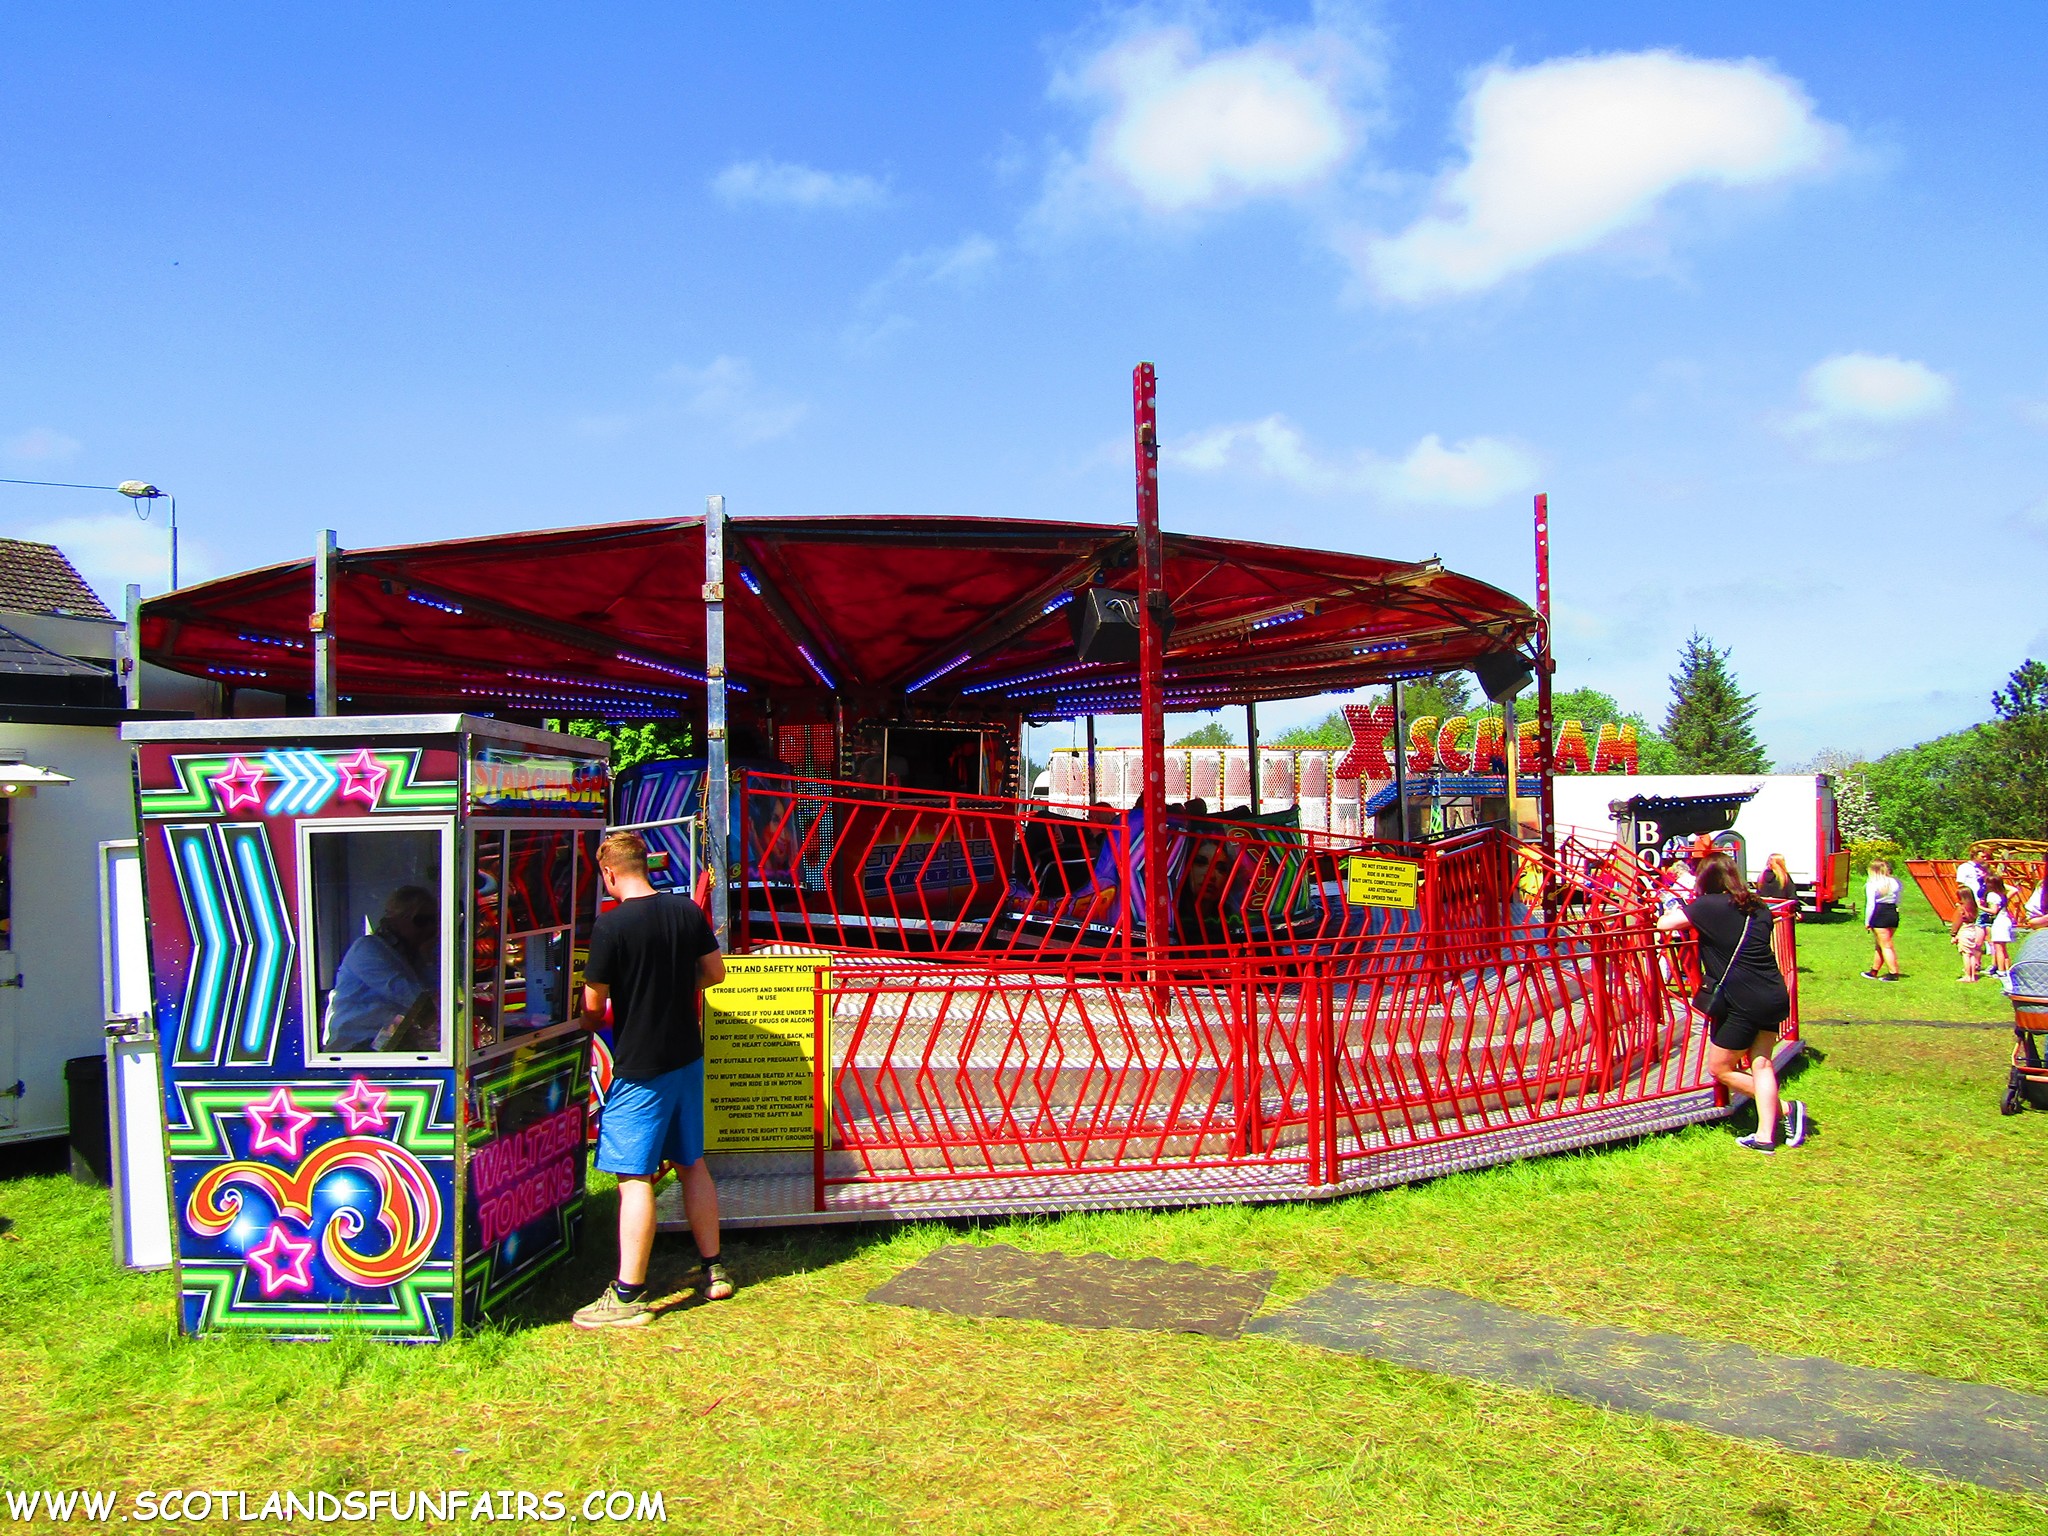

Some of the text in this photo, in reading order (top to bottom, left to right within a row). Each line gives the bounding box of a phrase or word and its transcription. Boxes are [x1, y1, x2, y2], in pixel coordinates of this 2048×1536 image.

[475, 764, 606, 804] STARCHASER
[725, 965, 825, 973] LTH AND SAFETY NOTI
[786, 1032, 805, 1040] BACK,
[474, 1106, 583, 1198] WALTZER
[479, 1156, 575, 1246] TOKENS
